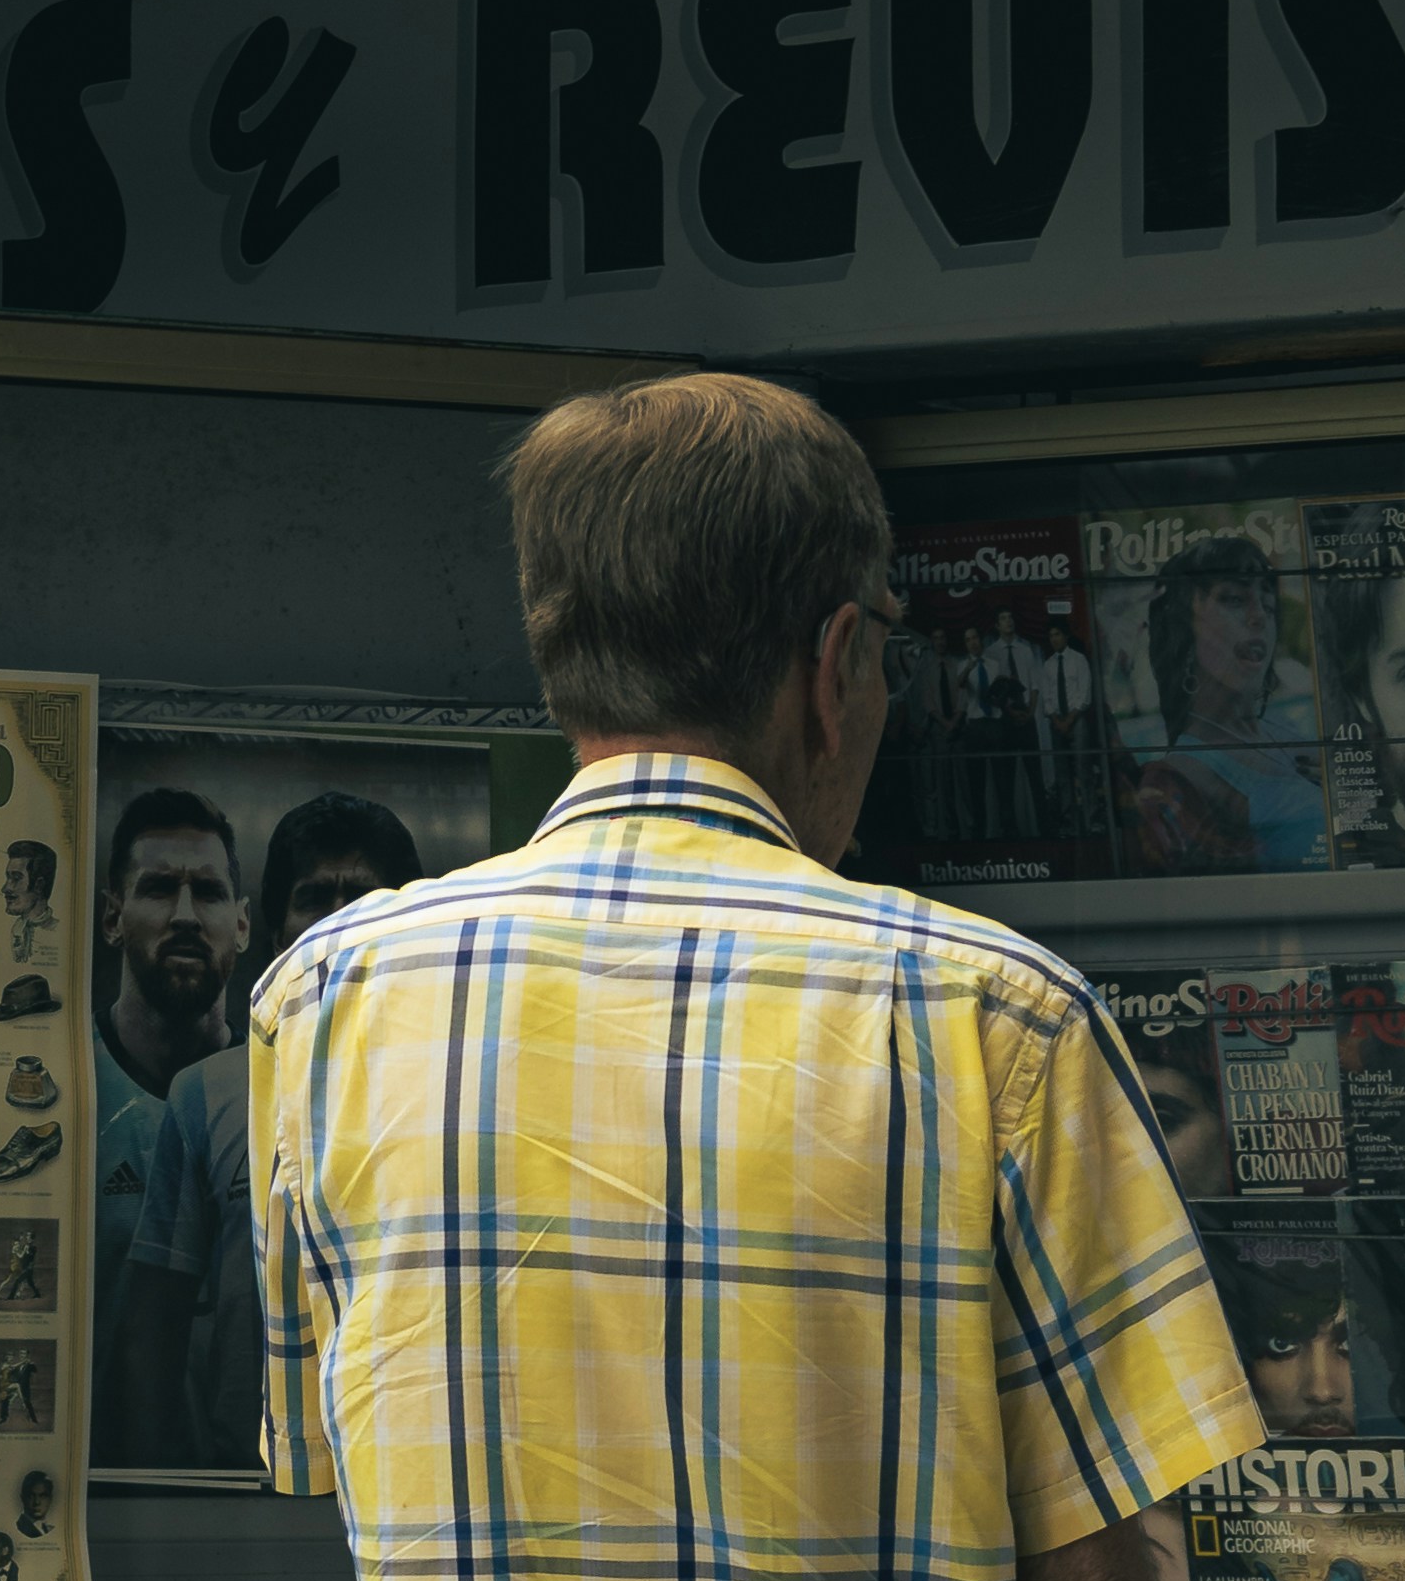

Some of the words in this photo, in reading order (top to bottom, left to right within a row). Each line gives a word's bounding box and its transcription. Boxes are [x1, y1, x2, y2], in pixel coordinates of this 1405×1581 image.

[1314, 532, 1383, 548] ESPECIAL
[1334, 747, 1374, 764] años
[920, 859, 1050, 884] Babasónicos
[1348, 1069, 1393, 1083] Gabriel
[1233, 1122, 1316, 1152] ETERNA
[1223, 1520, 1295, 1536] NATIONAL
[1224, 1537, 1316, 1556] GEOGRAPHIC
